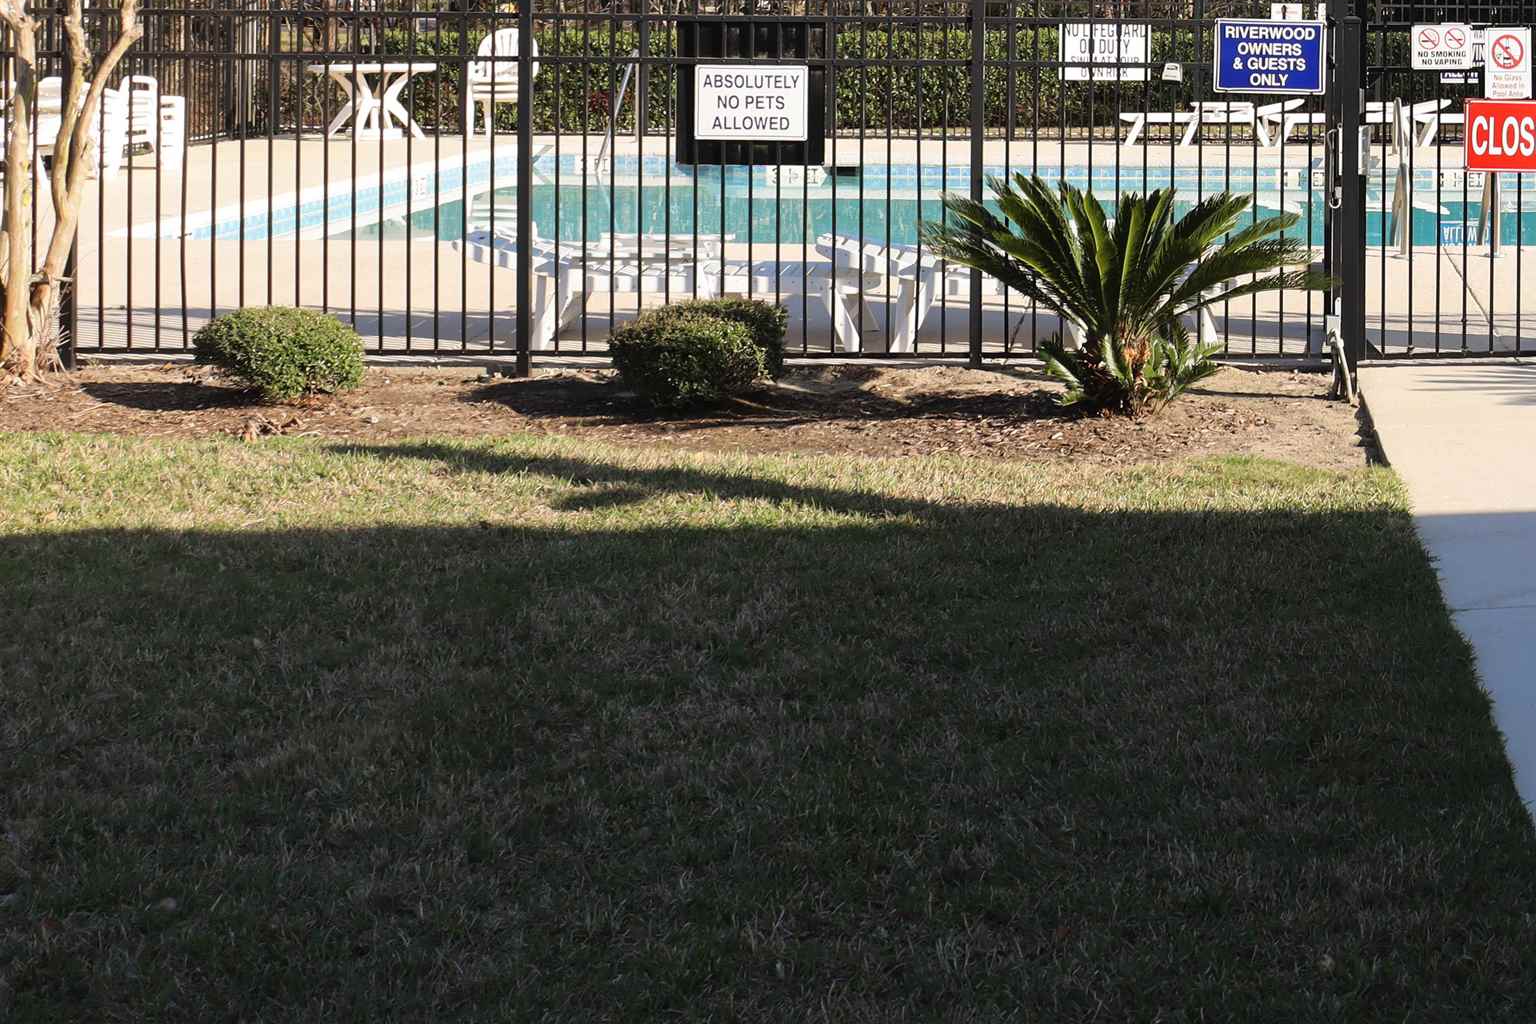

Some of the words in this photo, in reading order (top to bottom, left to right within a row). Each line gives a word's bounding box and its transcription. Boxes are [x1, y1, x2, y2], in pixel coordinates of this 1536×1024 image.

[1225, 26, 1316, 40] RIVERWOOD
[1237, 42, 1302, 56] OWNERS
[1233, 58, 1243, 70] &
[1247, 58, 1307, 71] GUESTS
[703, 74, 800, 88] ABSOLUTELY
[1249, 73, 1289, 86] ONLY
[717, 95, 740, 110] NO
[745, 95, 785, 110] PETS
[712, 116, 790, 130] ALLOWED
